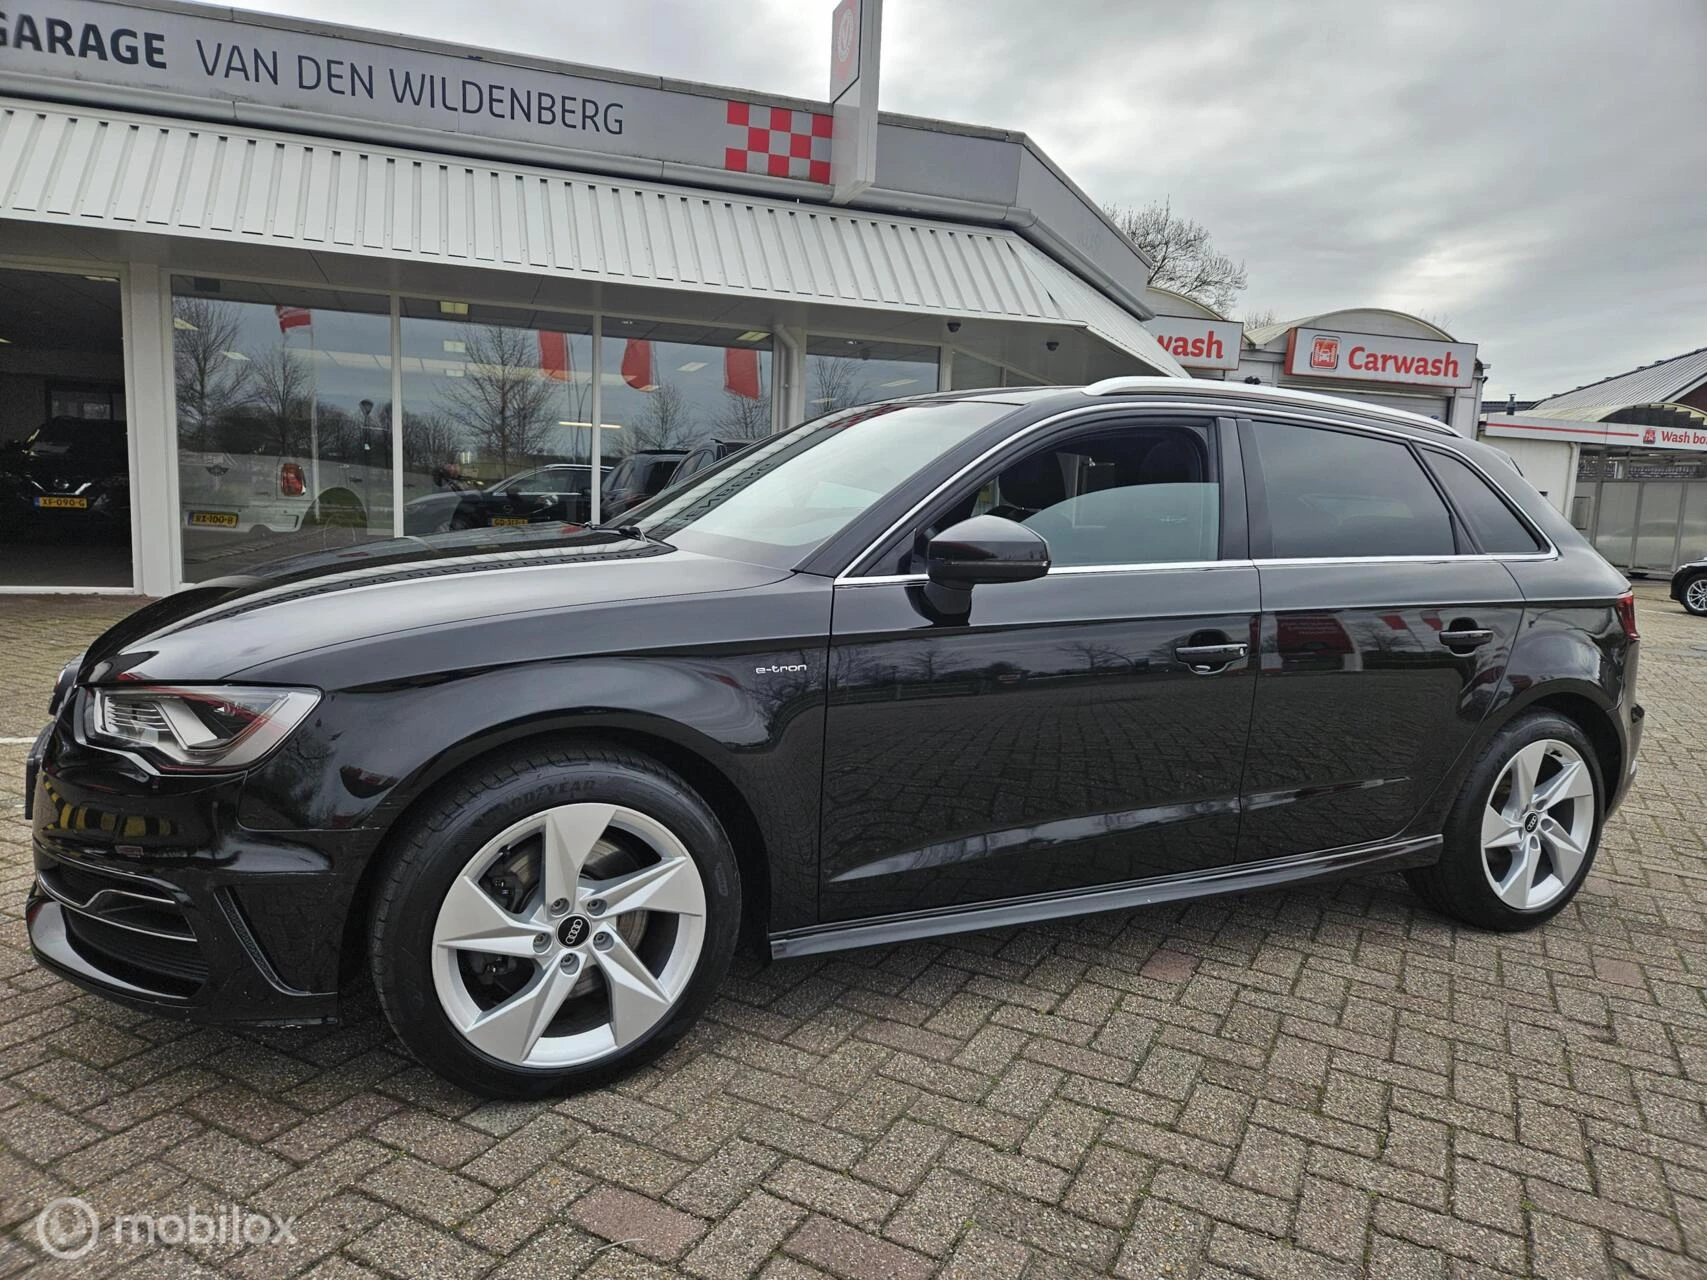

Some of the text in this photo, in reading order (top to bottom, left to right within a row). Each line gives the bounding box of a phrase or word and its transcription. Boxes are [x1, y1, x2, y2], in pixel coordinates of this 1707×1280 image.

[196, 39, 278, 85] VAN
[297, 54, 374, 99] DEN
[389, 68, 624, 135] WILDENBERG
[1348, 346, 1459, 378] Carwash
[1661, 430, 1707, 445] Wash bo
[755, 664, 807, 674] e-tron
